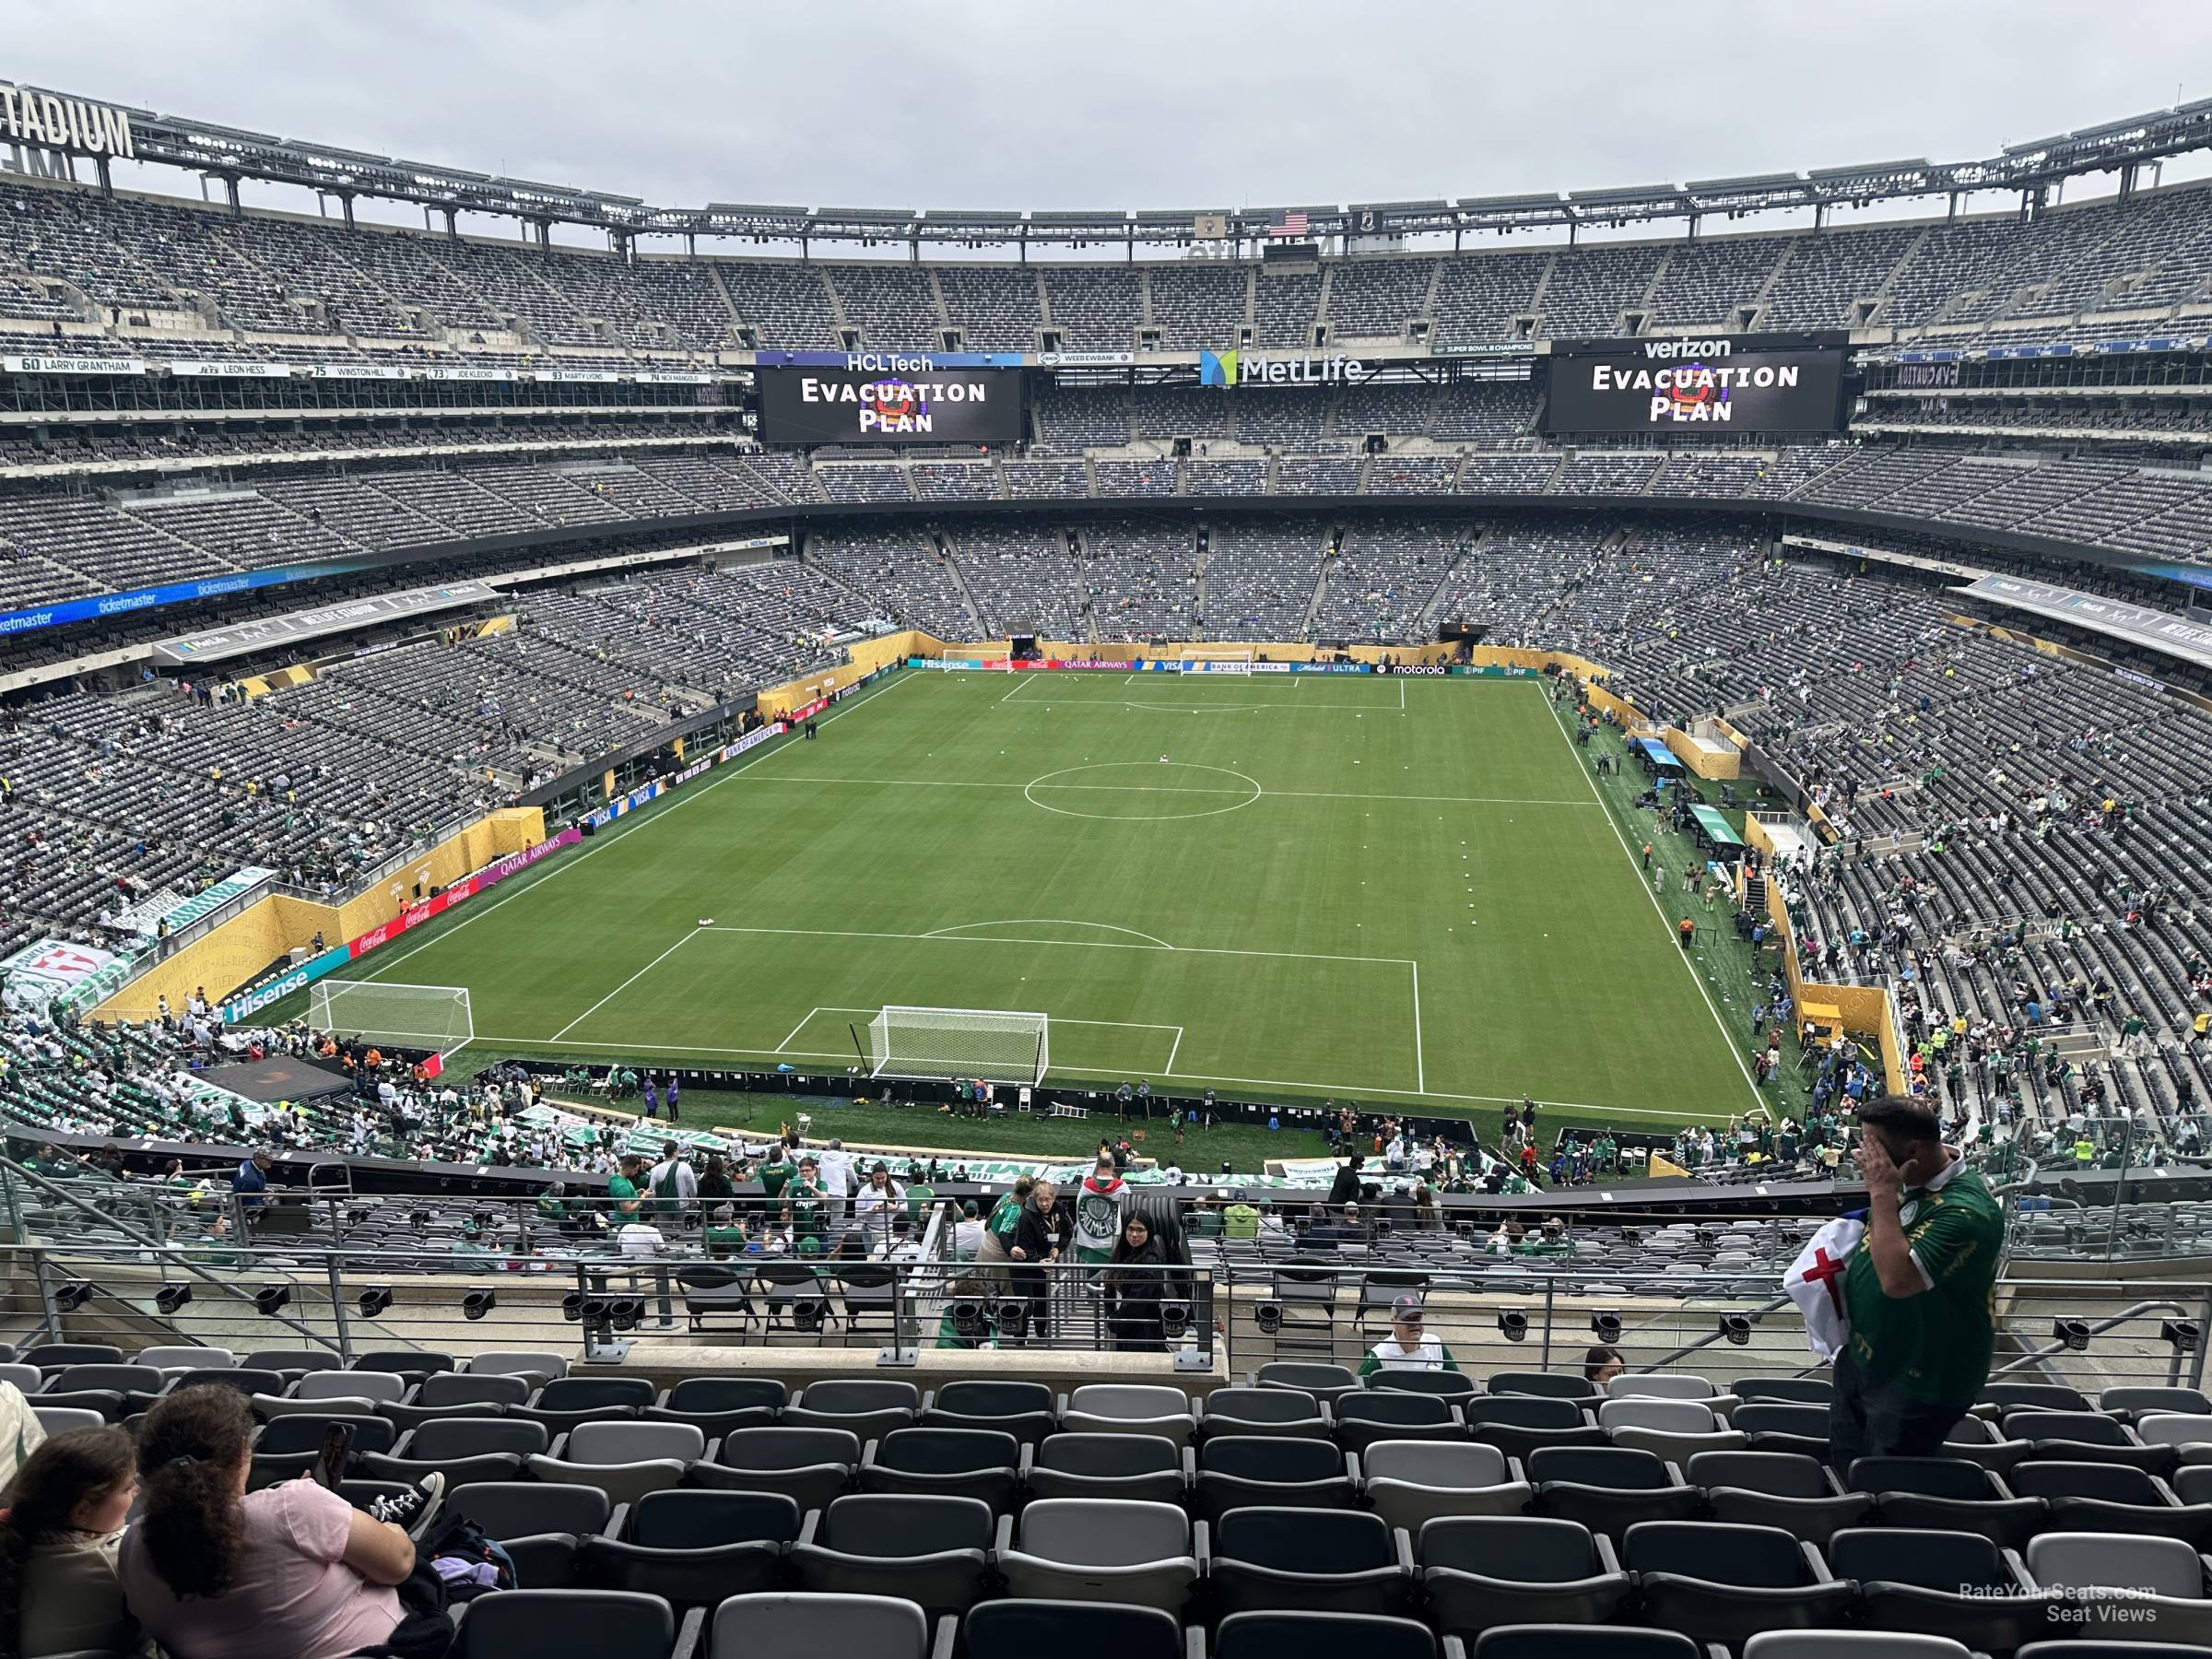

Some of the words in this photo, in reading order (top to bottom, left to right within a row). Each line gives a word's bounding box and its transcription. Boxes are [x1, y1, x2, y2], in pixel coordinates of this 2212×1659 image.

[0, 85, 134, 158] TADIUM
[1446, 345, 1467, 353] SUPER
[1495, 343, 1534, 352] CHAMPIONS
[1644, 337, 1730, 359] verizon
[22, 358, 41, 371] 60
[44, 360, 76, 371] LARRY
[77, 360, 131, 371] GRANTHAM
[224, 364, 243, 374] LEON
[245, 365, 265, 374] HESS
[847, 354, 933, 371] HCLTech
[1241, 353, 1362, 383] MetLife
[314, 366, 326, 376] 75
[337, 368, 369, 377] WINSTON
[369, 369, 386, 377] HILL
[433, 370, 444, 378] 73
[456, 371, 469, 379] JOE
[552, 371, 562, 380] 93
[564, 372, 585, 381] MARTY
[585, 372, 604, 382] LYONS
[673, 374, 699, 382] MANGOLD
[1593, 365, 1798, 390] EVACUATION
[801, 378, 985, 402] EVACUATION
[1650, 396, 1732, 421] PLAN
[859, 409, 933, 432] PLAN
[197, 576, 250, 595] ticketmaster
[451, 585, 477, 597] MetLife
[99, 592, 157, 612] ticketmaster
[300, 608, 335, 626] METLIFE
[335, 604, 377, 619] STADIUM
[194, 636, 229, 653] MetLife
[922, 659, 969, 670] Hisense
[1065, 661, 1091, 669] QATAR
[1093, 661, 1127, 669] AIRWAYS
[1162, 662, 1183, 670] VISA
[1212, 663, 1232, 671] BANK
[1233, 663, 1244, 671] OF
[1245, 663, 1278, 671] AMERICA
[1393, 665, 1445, 675] motorola
[2132, 674, 2146, 684] WORLD
[841, 683, 861, 699] motorola
[726, 745, 741, 758] BANK
[742, 739, 749, 750] OF
[749, 727, 773, 746] AMERICA
[632, 789, 651, 806] VISA
[594, 811, 612, 828] VISA
[500, 852, 528, 876] QATAR
[529, 835, 560, 861] AIRWAYS
[359, 926, 387, 953] Coca-Cola
[231, 971, 308, 1023] Hisense
[1078, 1211, 1116, 1237] PALMEIR
